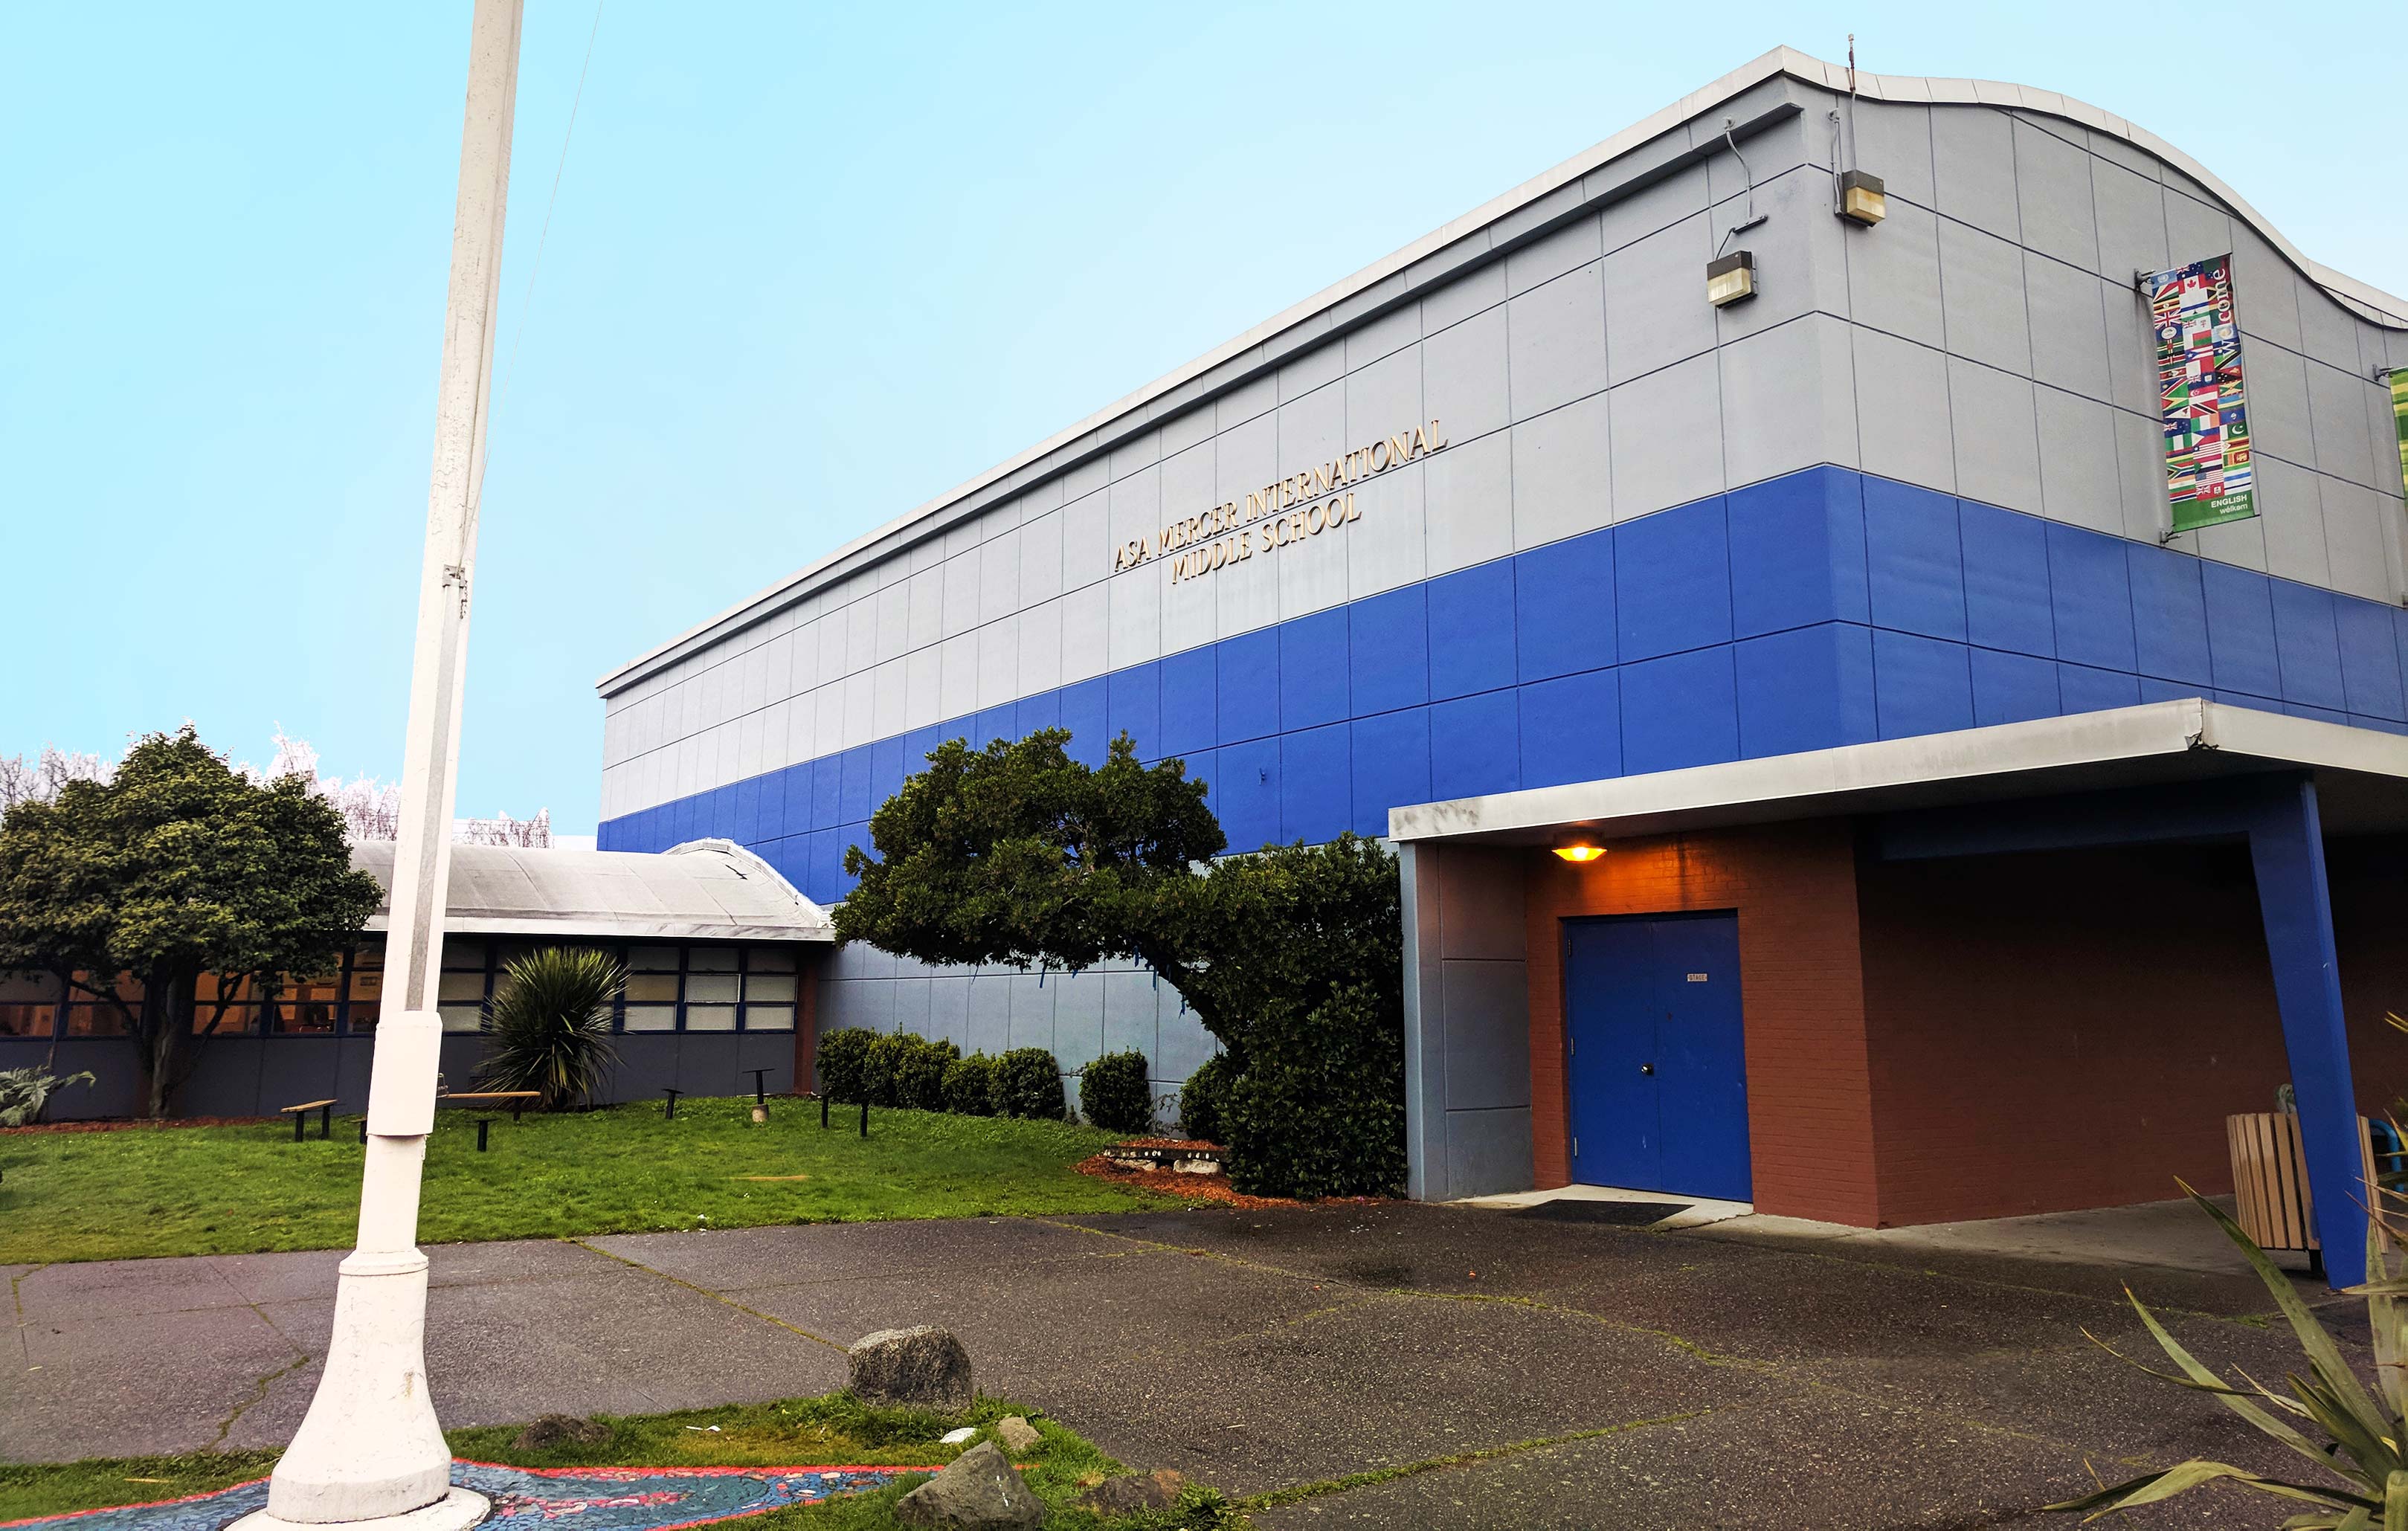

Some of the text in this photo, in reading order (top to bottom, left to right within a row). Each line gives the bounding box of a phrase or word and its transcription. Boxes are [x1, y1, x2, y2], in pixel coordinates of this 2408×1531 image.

[1115, 419, 1449, 573] ASA MERCER INTERNATIONAL
[1172, 492, 1362, 585] MIDDLE SCHOOL
[2211, 494, 2247, 508] ENGLISH
